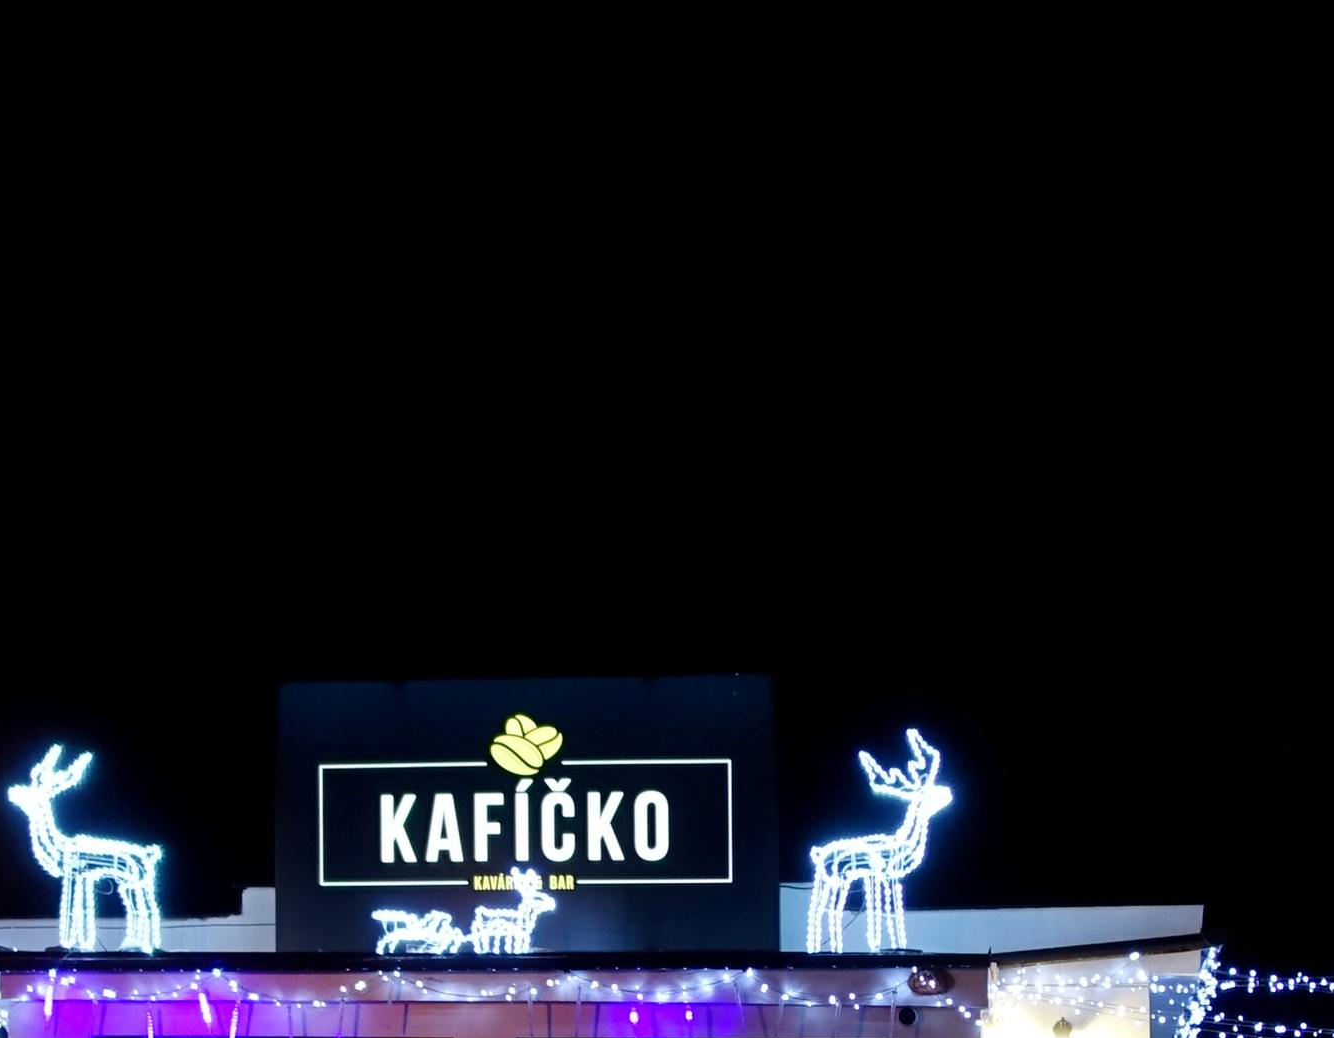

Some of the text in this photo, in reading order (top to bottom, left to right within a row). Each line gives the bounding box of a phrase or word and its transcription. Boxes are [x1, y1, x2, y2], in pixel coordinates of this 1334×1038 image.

[379, 777, 669, 863] KAFÍČKO
[473, 873, 526, 890] KAVÁR
[549, 874, 575, 890] BAR
